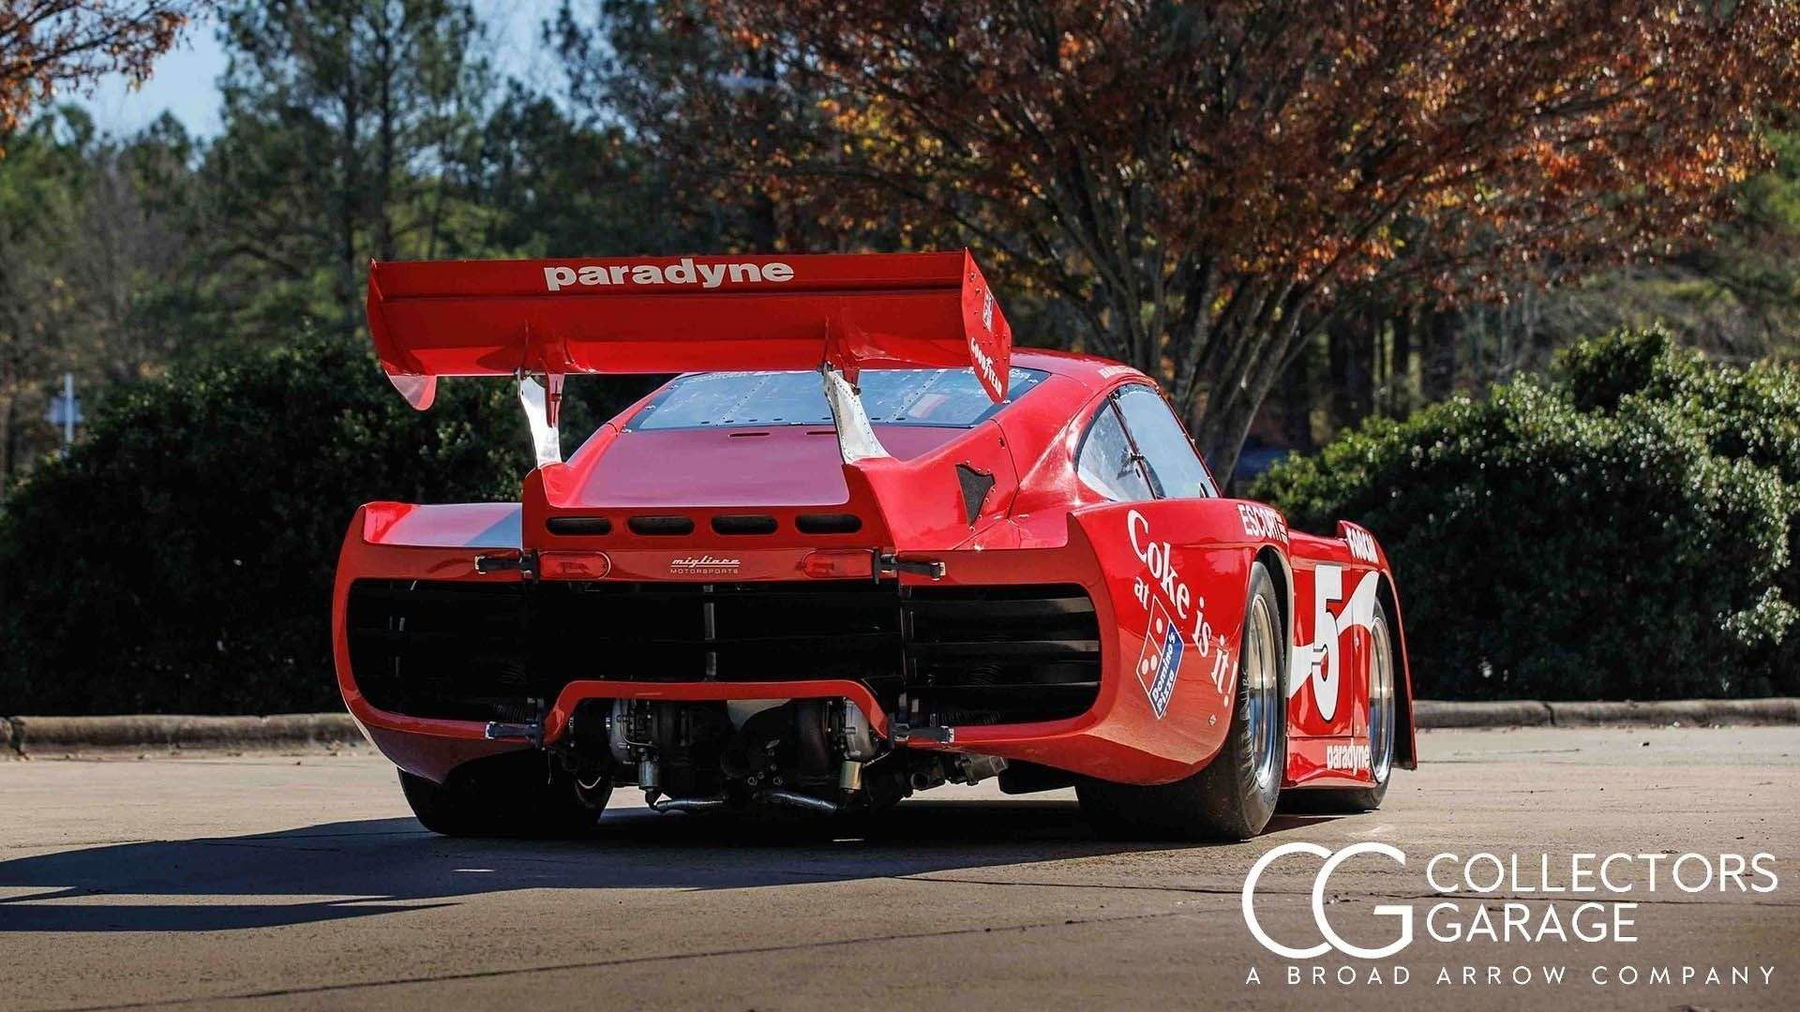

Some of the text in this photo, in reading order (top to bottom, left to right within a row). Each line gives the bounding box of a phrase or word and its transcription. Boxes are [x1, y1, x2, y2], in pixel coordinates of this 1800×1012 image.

[543, 258, 795, 292] paradyne
[1127, 509, 1190, 620] Coke
[1192, 596, 1212, 658] is
[1134, 576, 1149, 611] at
[1311, 562, 1342, 723] 5
[1157, 669, 1175, 713] Pizza
[1326, 737, 1371, 776] paradyne
